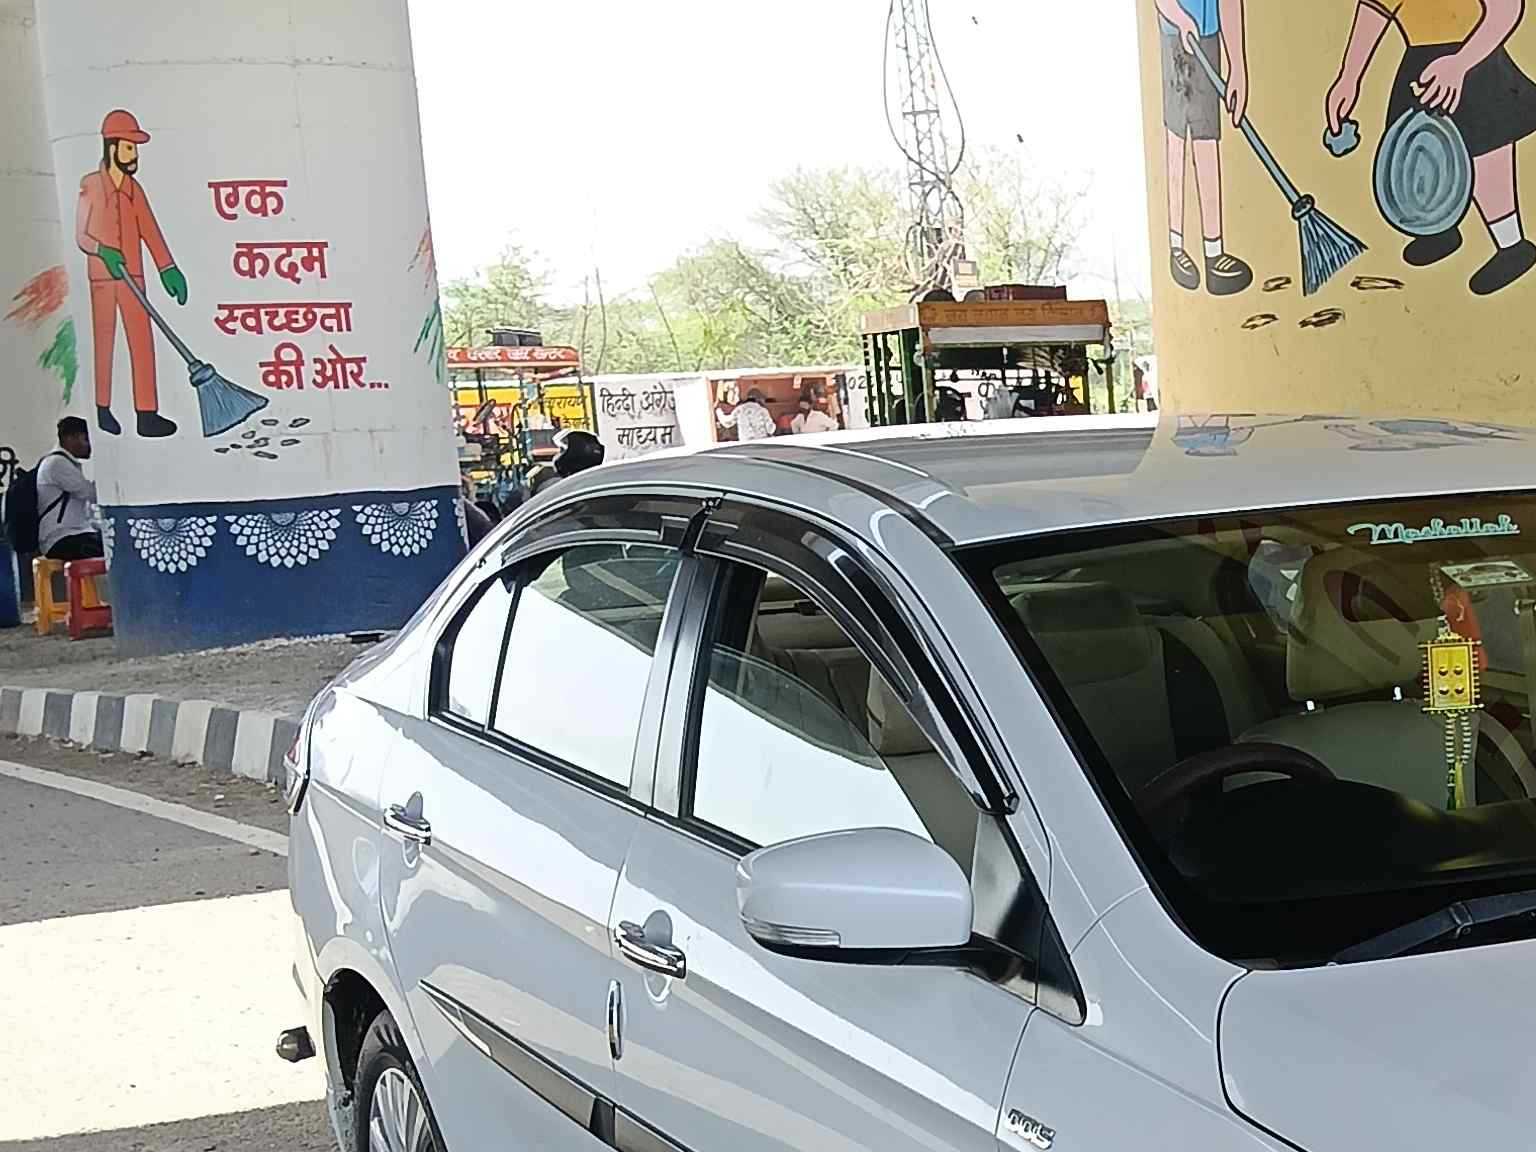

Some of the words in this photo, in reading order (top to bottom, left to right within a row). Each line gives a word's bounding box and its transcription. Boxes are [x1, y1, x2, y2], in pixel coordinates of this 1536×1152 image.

[207, 180, 288, 220] एक
[233, 241, 328, 284] कदम
[214, 302, 352, 335] स्वच्छता
[259, 342, 304, 389] की
